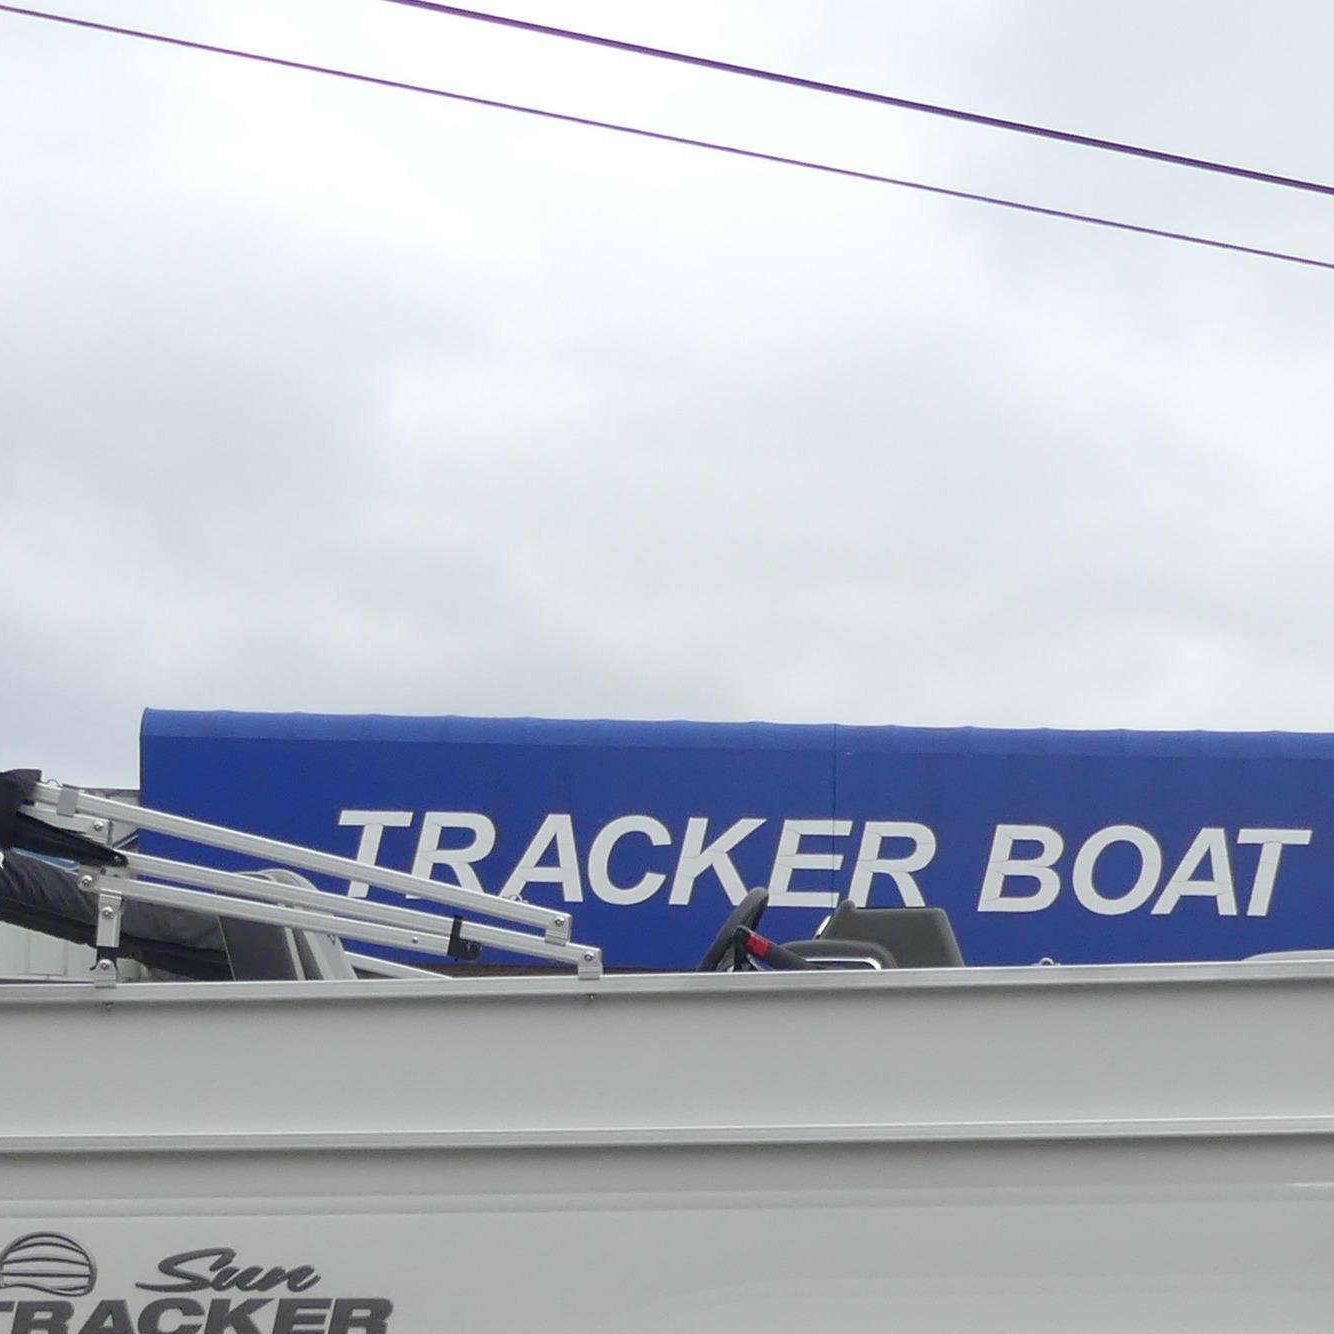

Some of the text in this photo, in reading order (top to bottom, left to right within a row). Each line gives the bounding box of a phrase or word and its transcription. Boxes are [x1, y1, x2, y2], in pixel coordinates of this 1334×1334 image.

[337, 809, 937, 908] TRACKER
[976, 824, 1312, 917] BOAT
[134, 1247, 322, 1293] Sun
